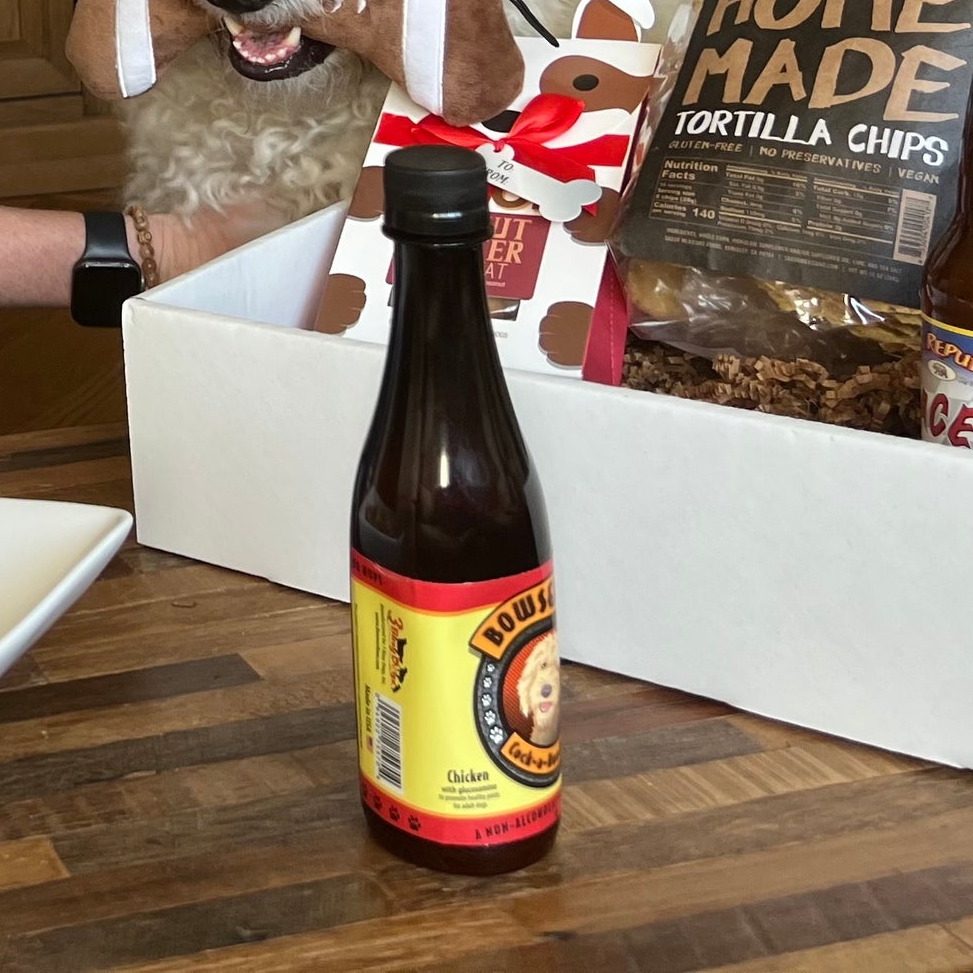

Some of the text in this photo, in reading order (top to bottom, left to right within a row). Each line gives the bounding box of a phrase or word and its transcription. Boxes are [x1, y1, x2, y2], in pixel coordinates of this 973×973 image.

[682, 37, 967, 122] MADE
[675, 110, 949, 166] TORTILLA CHIPS
[664, 160, 719, 172] Nutrition
[668, 139, 743, 154] GLUTEN-FREE
[759, 146, 777, 158] NO
[781, 148, 882, 174] PRESERVATIVES
[897, 167, 939, 185] VEGAN
[661, 170, 696, 181] Facts
[653, 202, 716, 219] Calories 140
[492, 217, 532, 241] UT
[486, 239, 524, 264] ER
[485, 262, 509, 280] AT
[926, 391, 973, 449] CE
[447, 768, 489, 784] Chicken
[475, 828, 482, 841] A
